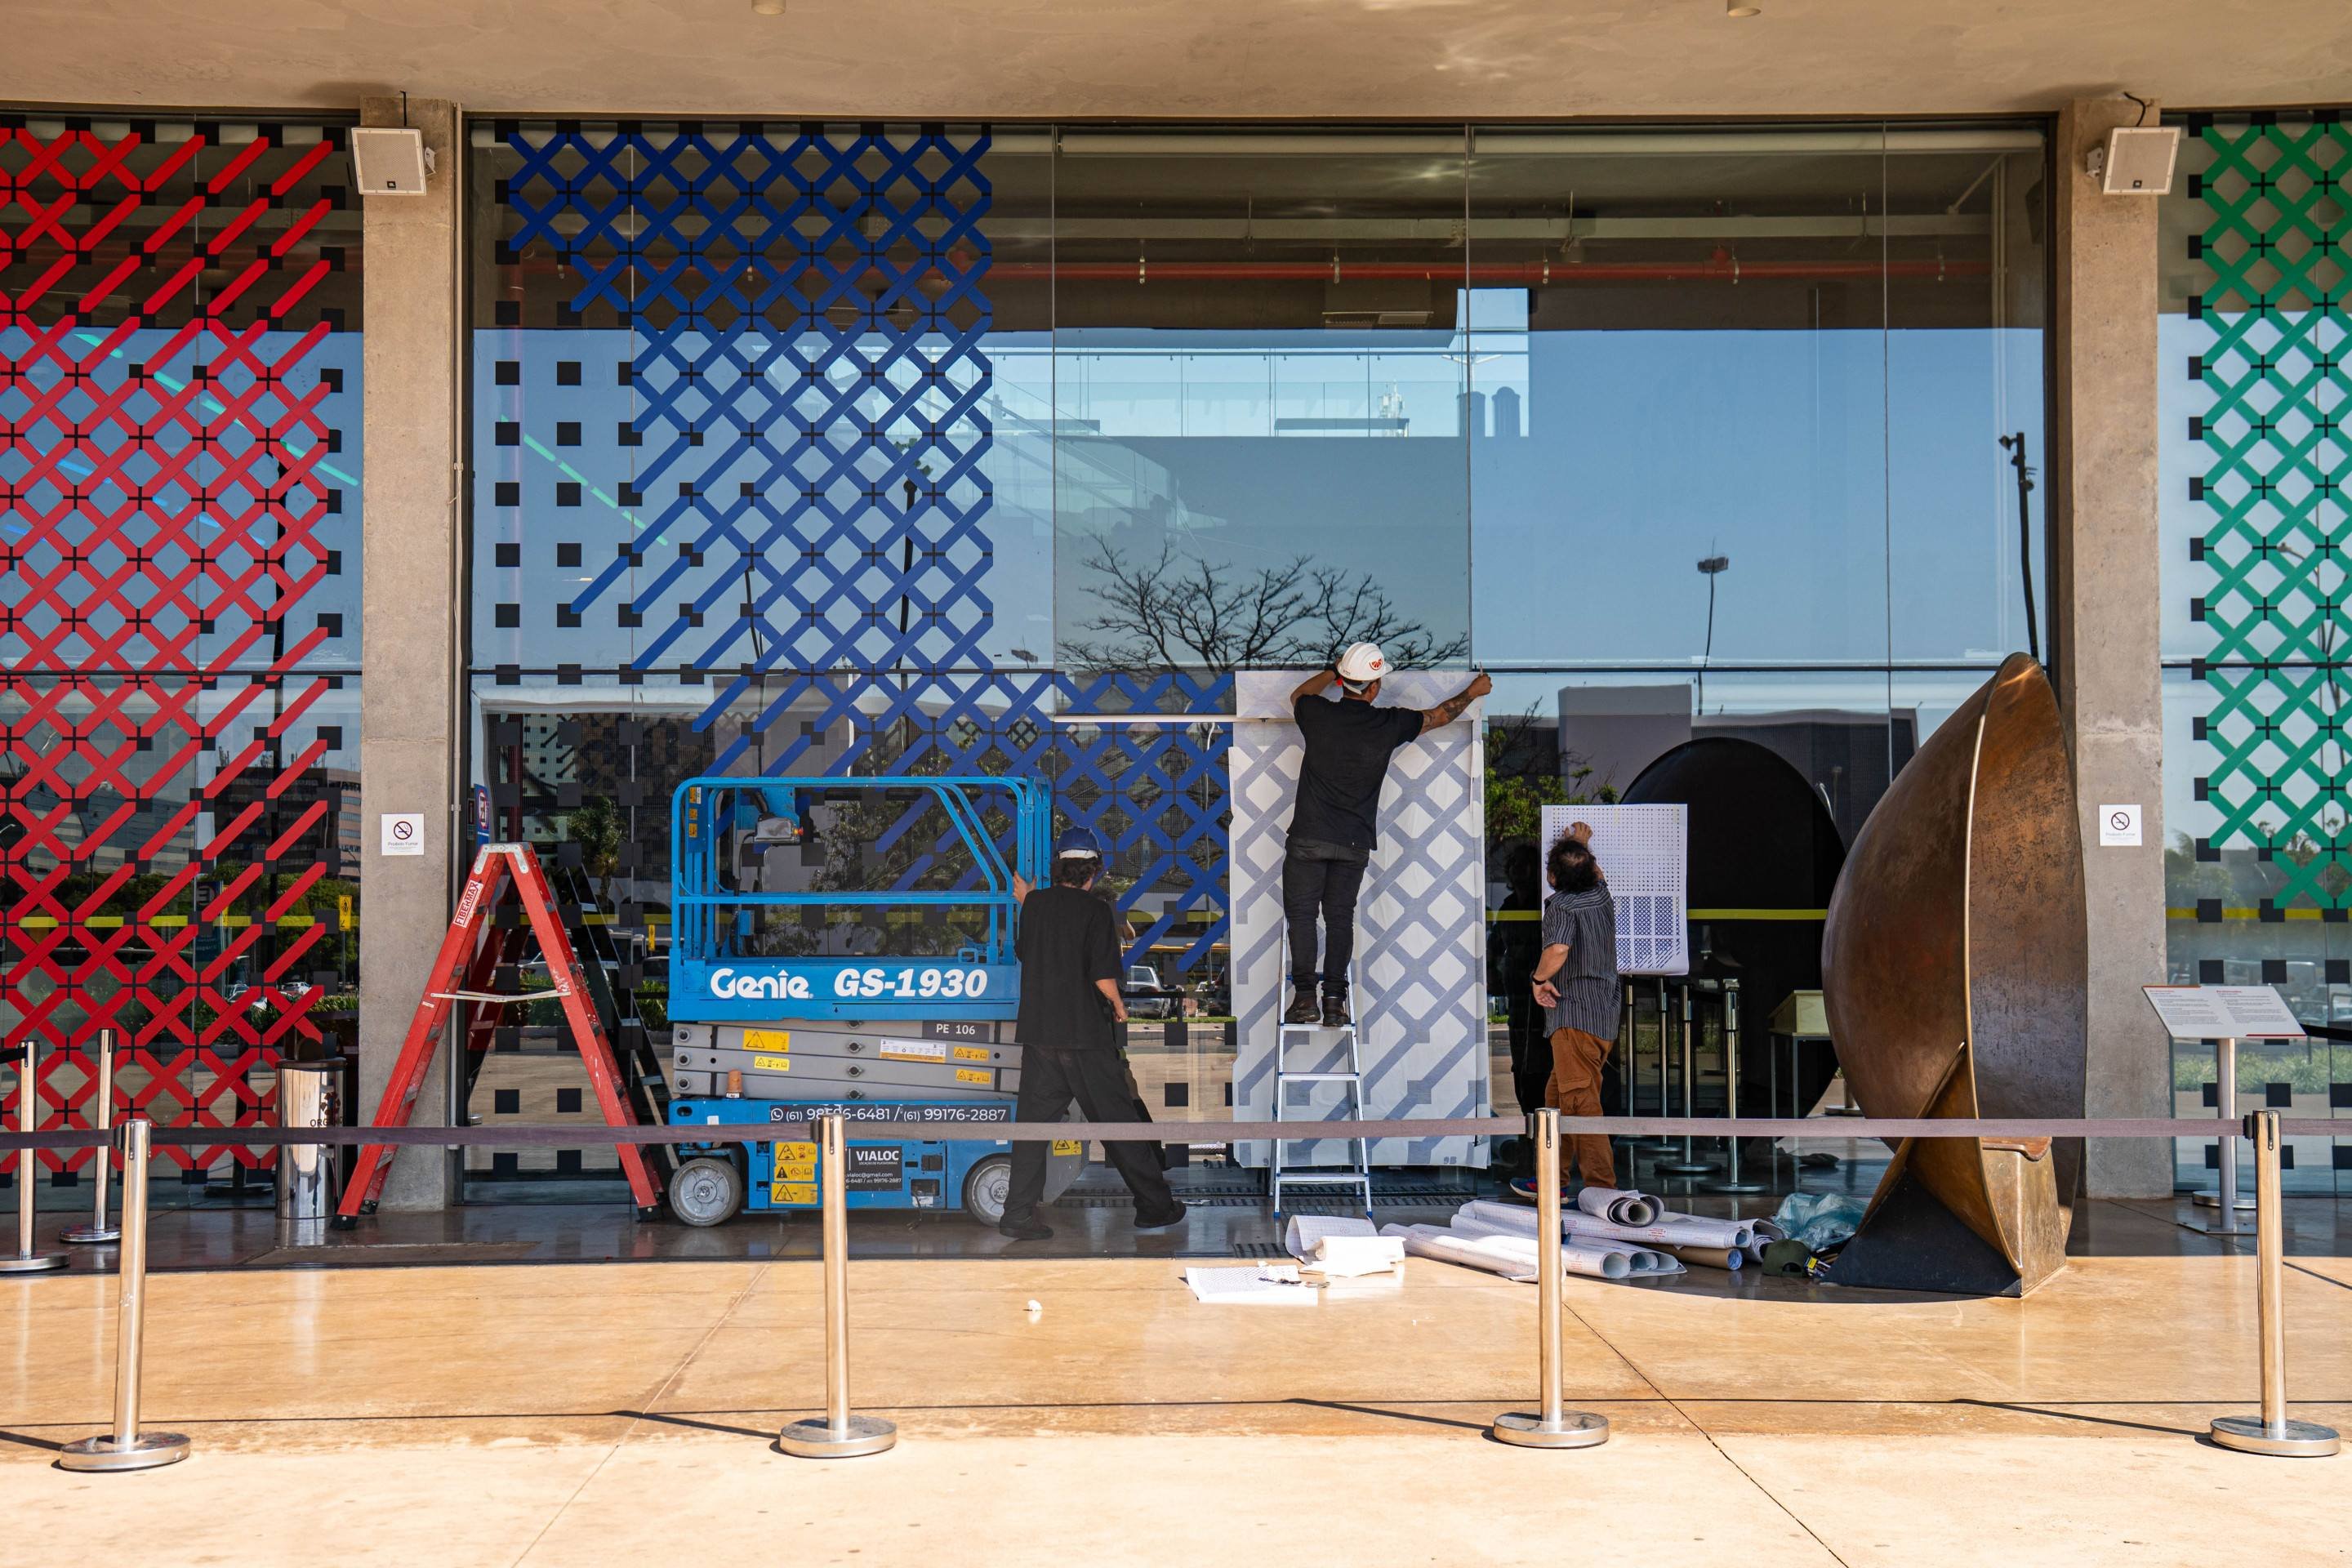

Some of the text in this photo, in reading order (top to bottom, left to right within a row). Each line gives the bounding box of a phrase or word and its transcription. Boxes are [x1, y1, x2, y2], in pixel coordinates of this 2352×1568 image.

[455, 880, 479, 925] FIBERMAX
[710, 969, 987, 999] Genie GS-1930
[936, 1023, 976, 1035] PE 106
[786, 1111, 803, 1121] (61)
[903, 1111, 920, 1122] (61)
[924, 1108, 1006, 1121] 99176-2887
[856, 1151, 899, 1160] VIALOC
